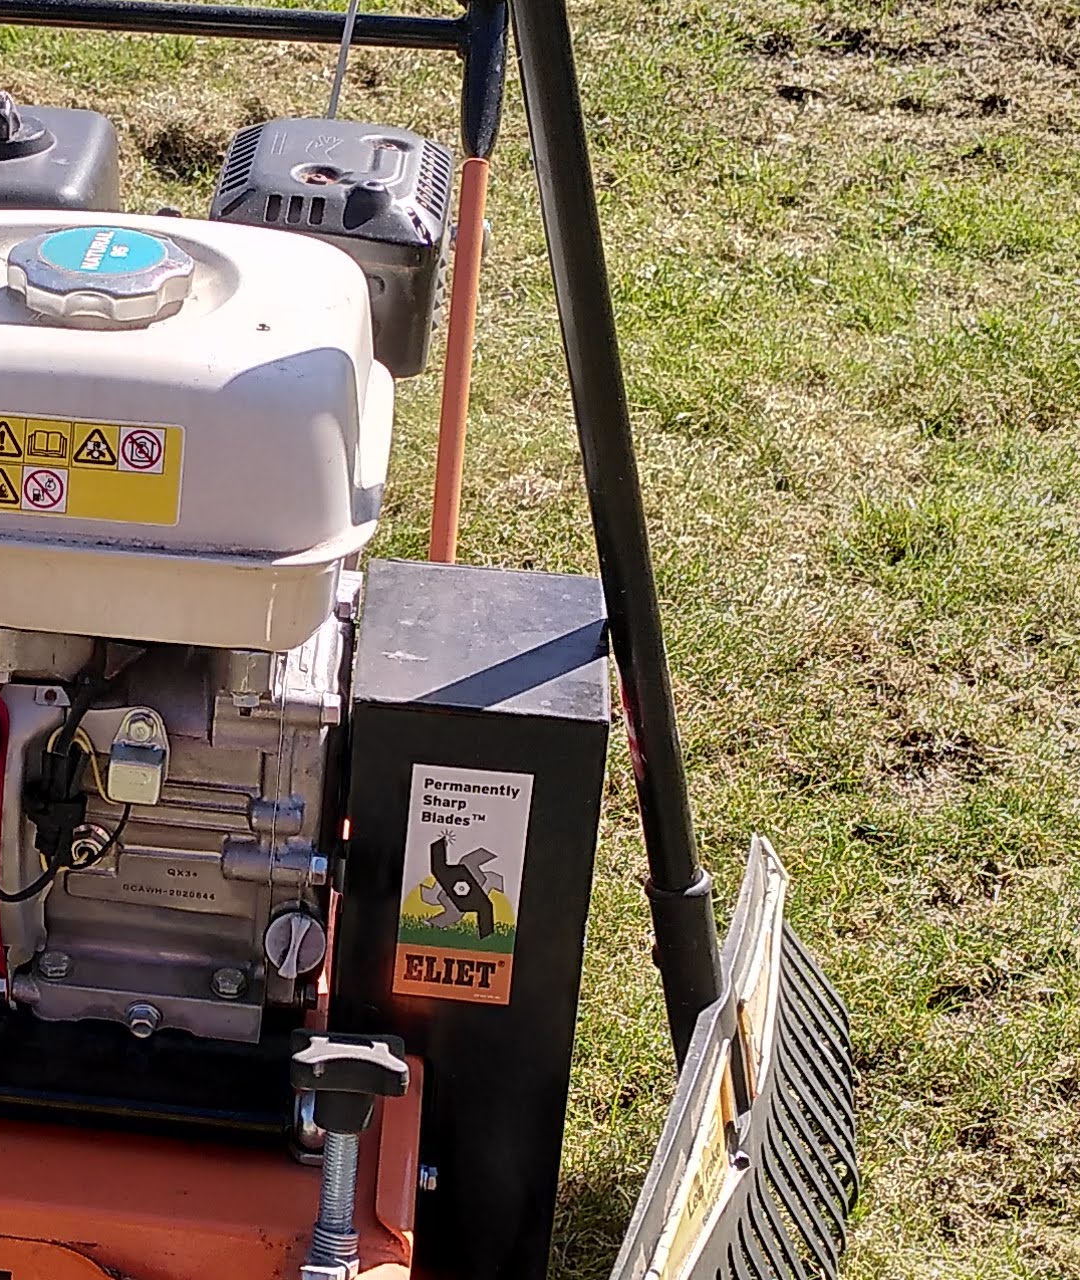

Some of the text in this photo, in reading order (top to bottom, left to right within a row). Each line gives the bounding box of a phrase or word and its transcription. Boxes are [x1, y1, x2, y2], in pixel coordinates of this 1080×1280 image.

[80, 230, 115, 270] NATURAL
[424, 778, 520, 799] Permanently
[423, 795, 467, 811] Sharp
